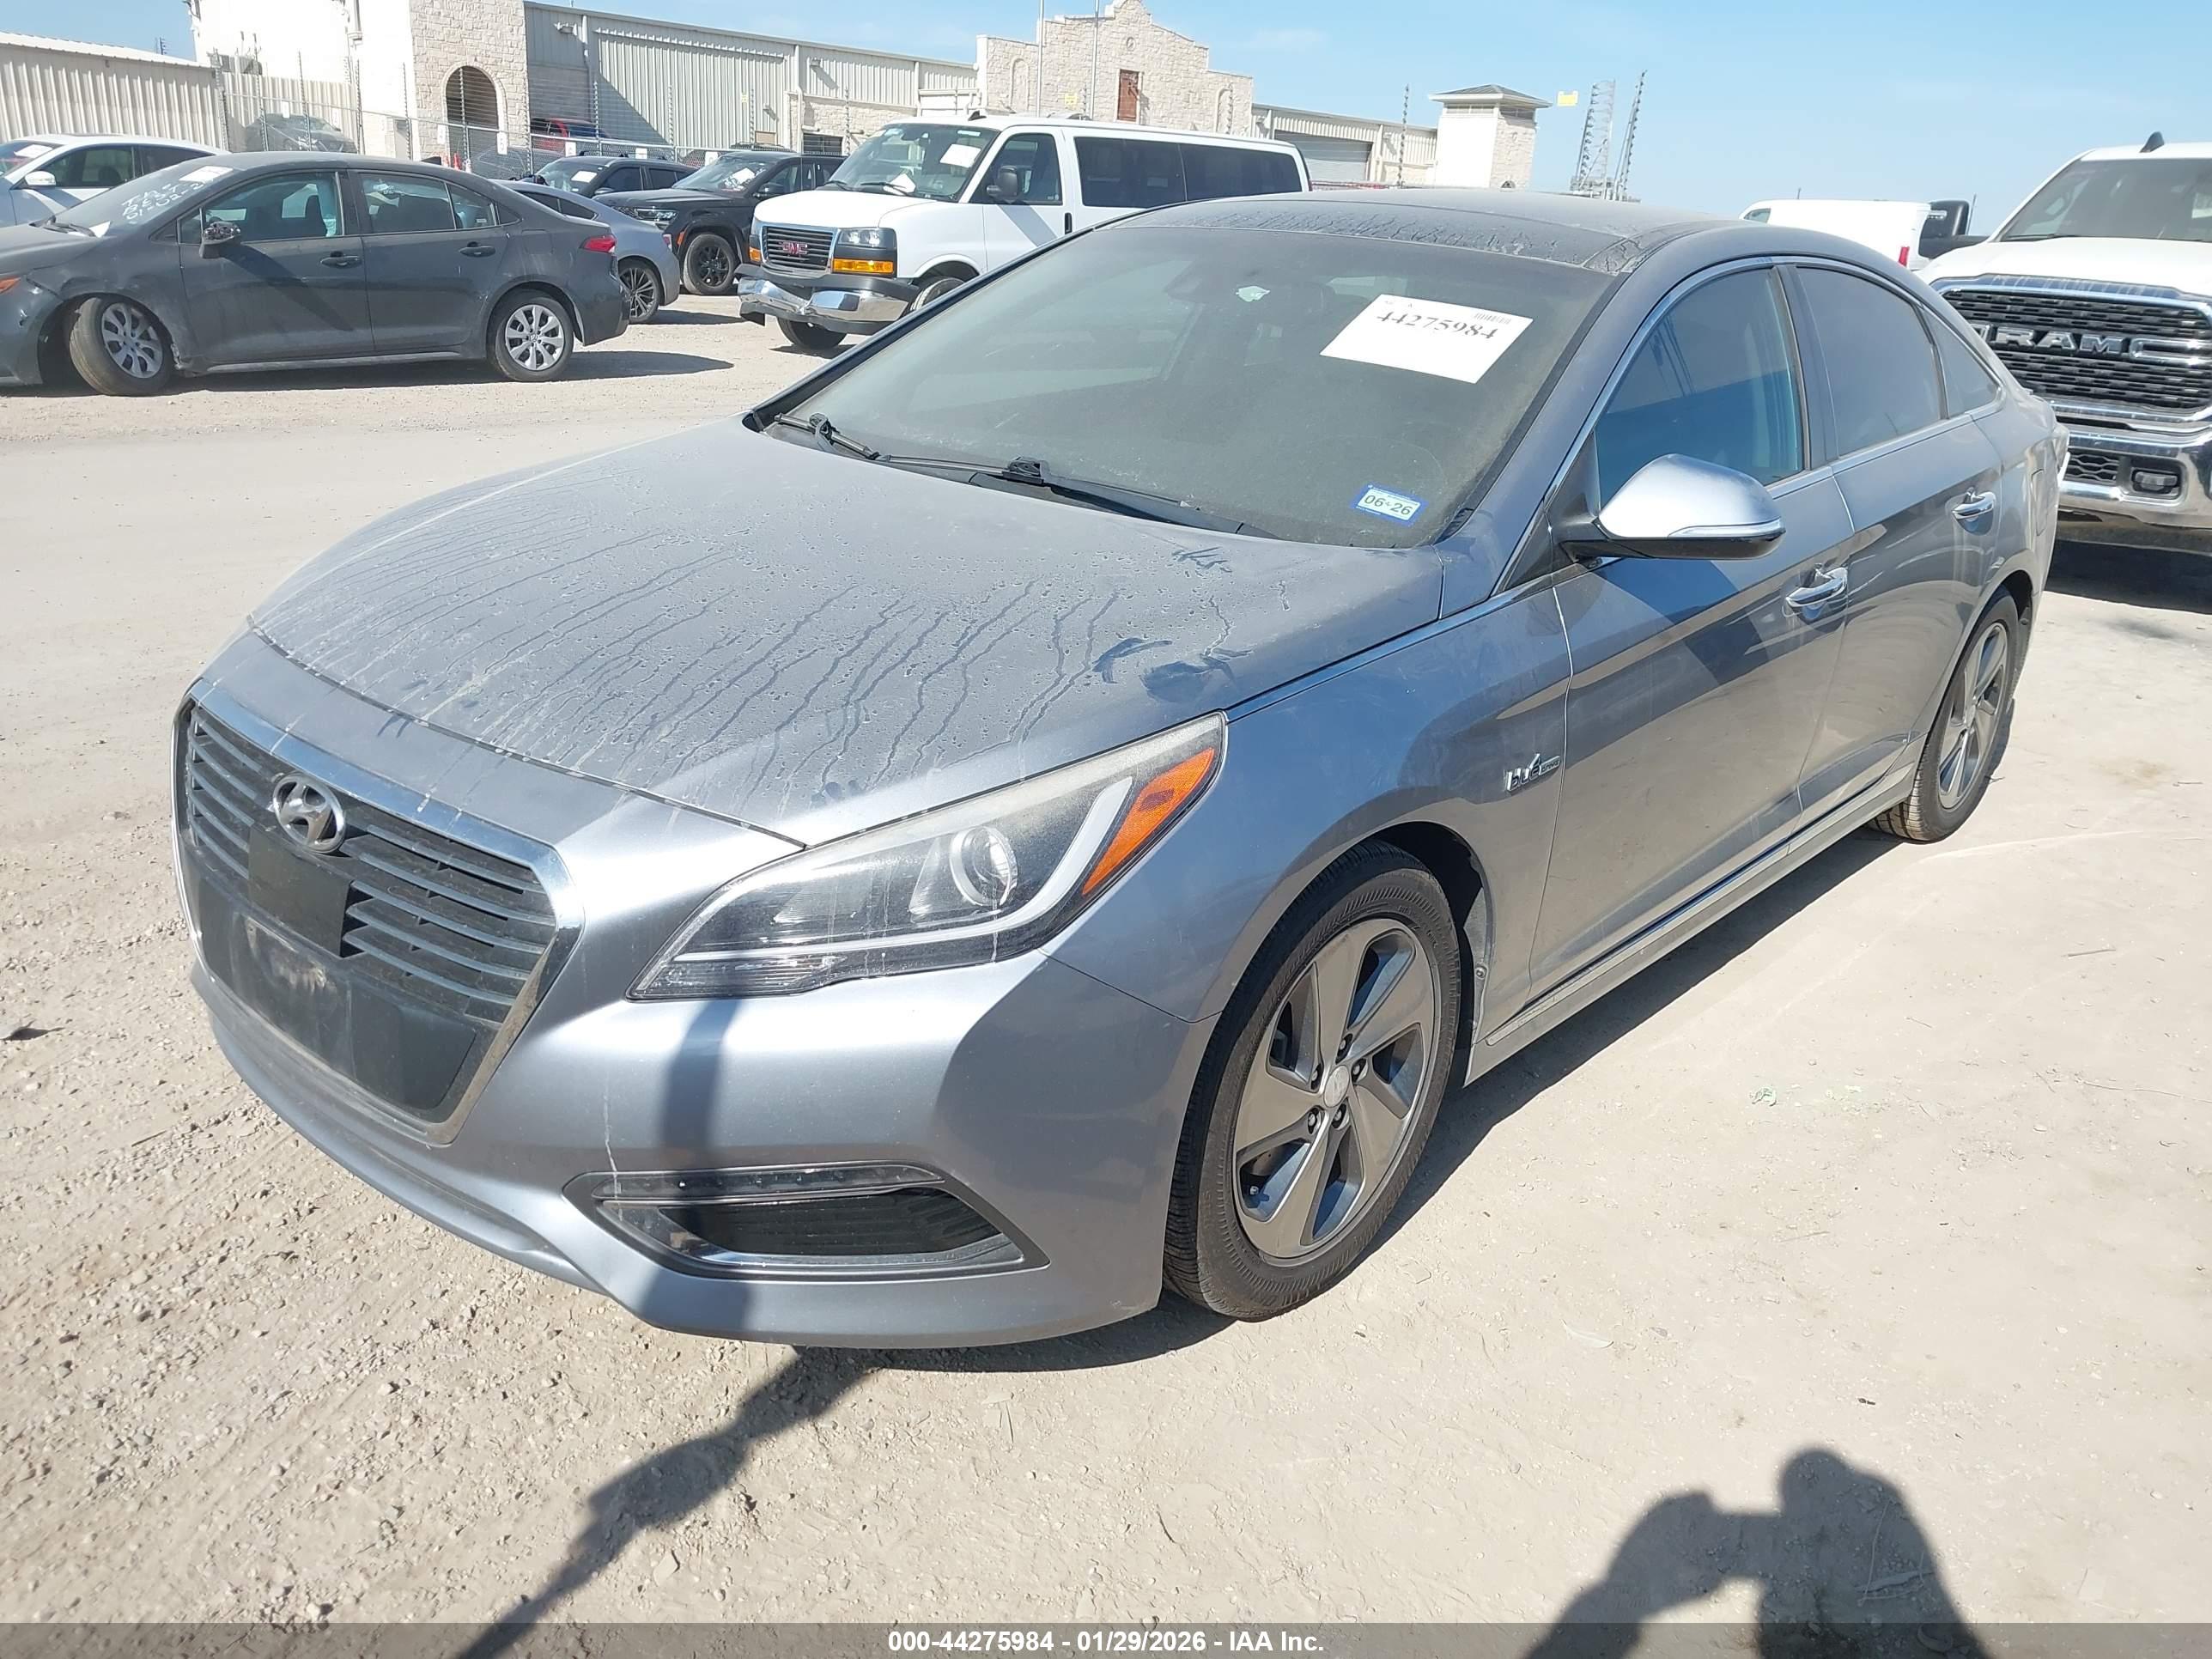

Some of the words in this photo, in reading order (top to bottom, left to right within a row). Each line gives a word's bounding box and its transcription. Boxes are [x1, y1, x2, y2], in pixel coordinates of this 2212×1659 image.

[782, 240, 808, 255] GMC
[1376, 312, 1498, 339] 44275984
[1995, 326, 2124, 355] RAM
